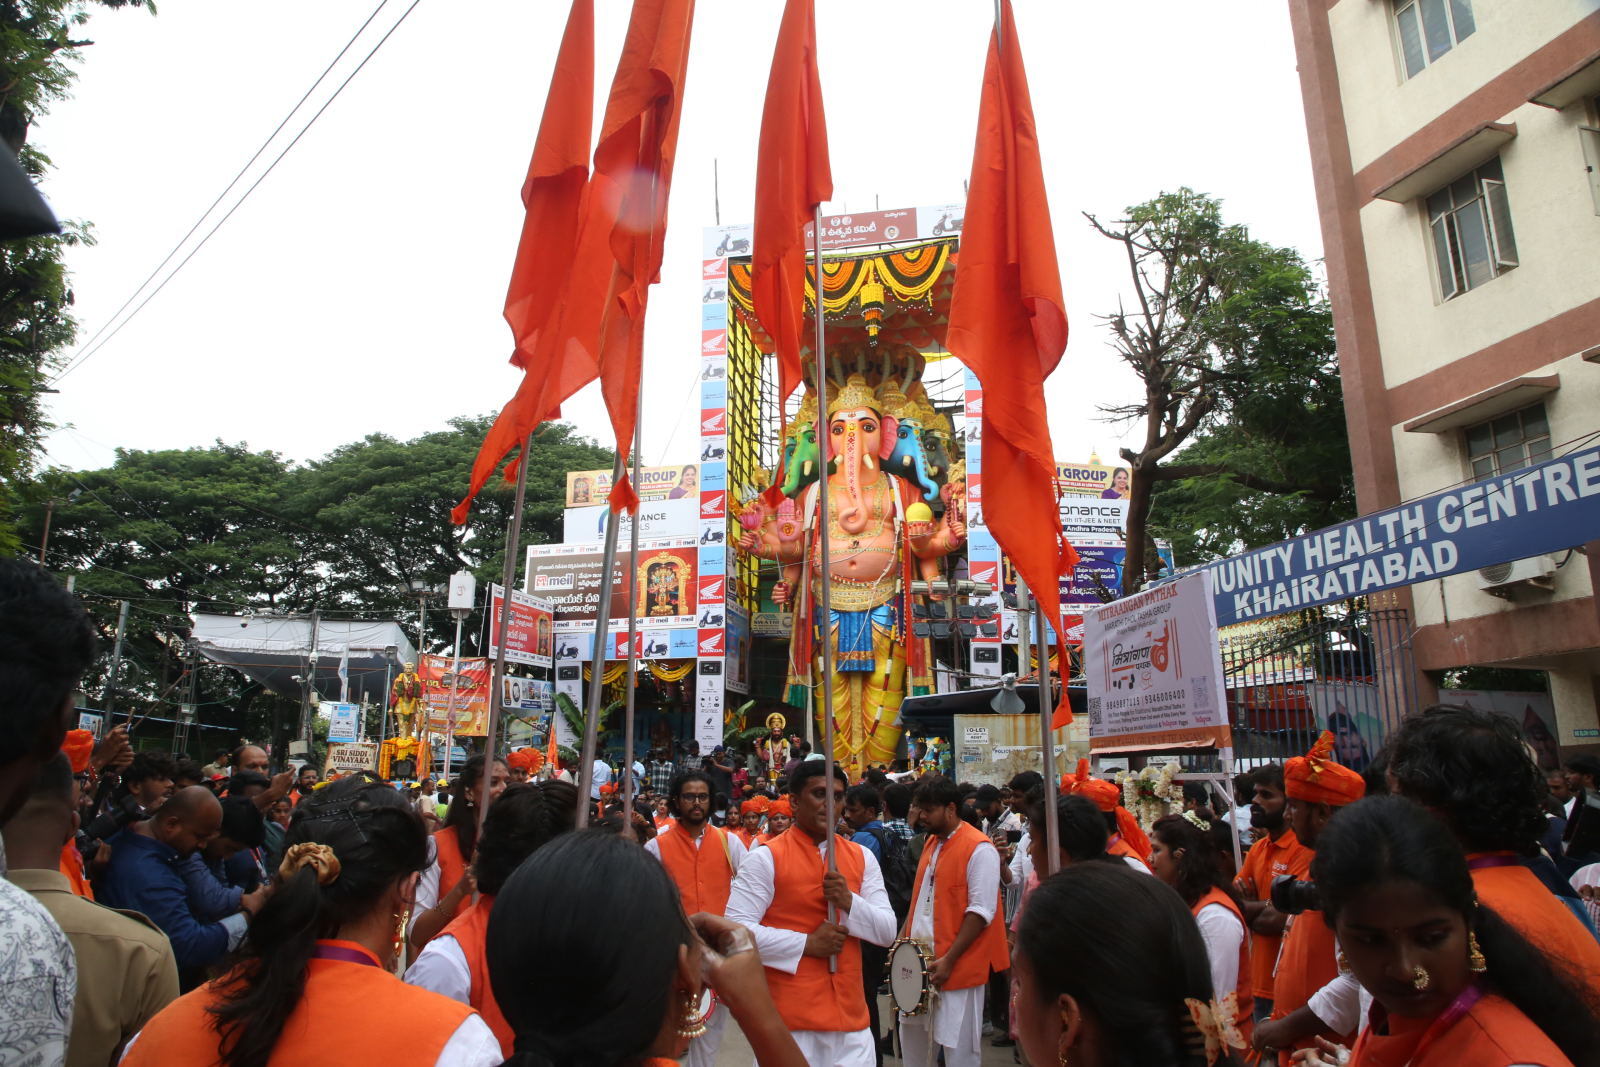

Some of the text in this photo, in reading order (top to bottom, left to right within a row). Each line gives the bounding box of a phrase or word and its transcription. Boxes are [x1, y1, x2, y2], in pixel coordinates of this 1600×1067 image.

[1063, 468, 1108, 481] GROUP
[1303, 504, 1428, 570] HEALTH
[1437, 451, 1600, 534] CENTRE
[620, 512, 667, 524] SOANCE
[549, 574, 573, 586] meil
[1233, 540, 1458, 620] KHAIRATABAD
[586, 592, 600, 603] చవి
[1146, 583, 1178, 606] PATHAK
[1137, 608, 1152, 620] TASHA
[1153, 602, 1172, 616] GROUP
[333, 756, 370, 764] VINAYAKA
